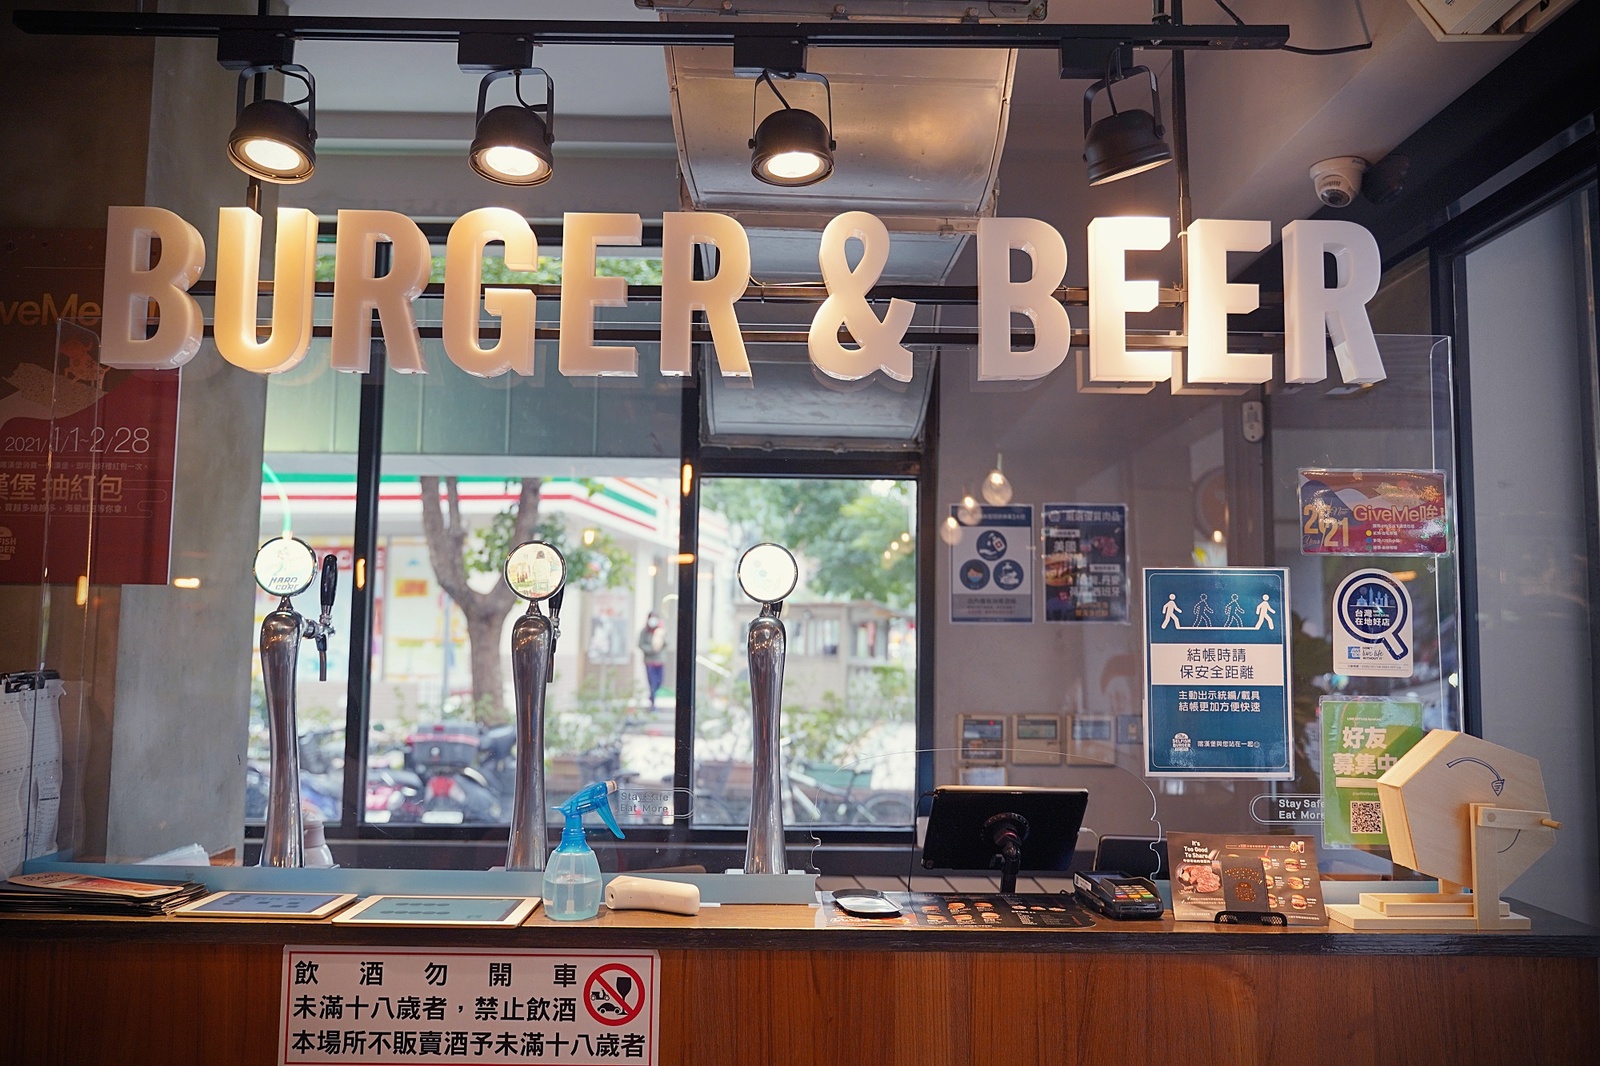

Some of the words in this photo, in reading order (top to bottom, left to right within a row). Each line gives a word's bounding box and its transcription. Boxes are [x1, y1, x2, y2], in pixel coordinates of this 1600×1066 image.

[100, 206, 753, 379] BURGER
[808, 211, 918, 384] &
[977, 216, 1387, 386] BEER
[1355, 608, 1373, 617] 台灣
[1354, 618, 1390, 626] 在地好店
[1187, 648, 1246, 662] 結帳時請
[1180, 665, 1254, 679] 保安全距離
[1178, 690, 1261, 701] 主動出示統編/載具
[1178, 702, 1261, 712] 結帳更加方便快速
[1342, 726, 1387, 749] 好友
[1333, 752, 1398, 776] 募集中
[620, 791, 640, 803] Stay
[620, 803, 637, 812] Eat
[642, 803, 669, 813] More
[1278, 798, 1302, 810] Stay
[1278, 810, 1297, 820] Eat
[294, 961, 578, 988] 飲酒勿開車
[293, 995, 577, 1022] 未滿十八歲者，禁止飲酒
[291, 1031, 646, 1058] 本場所不販賣酒予未滿十八歲者
